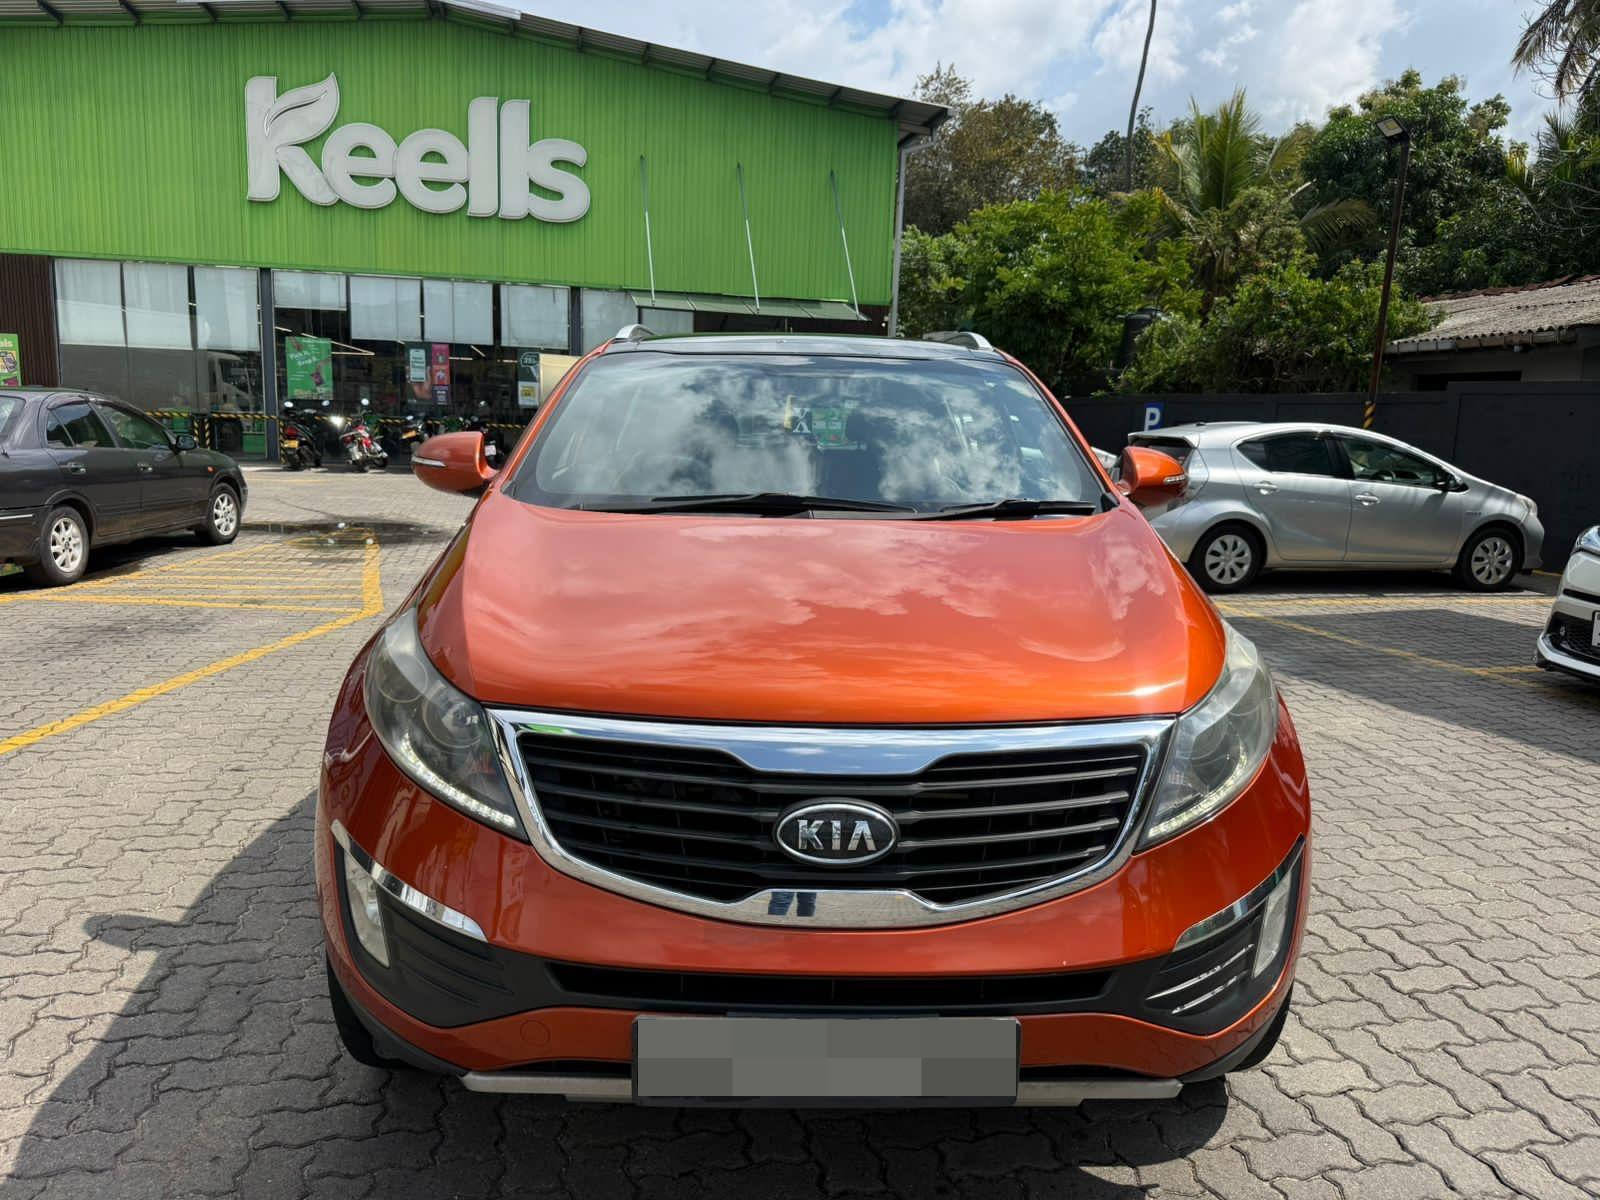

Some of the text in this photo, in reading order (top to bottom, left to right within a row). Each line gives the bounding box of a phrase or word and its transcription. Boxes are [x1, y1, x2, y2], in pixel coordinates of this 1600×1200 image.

[245, 72, 591, 223] Keells
[1144, 407, 1161, 432] P
[797, 819, 877, 851] KIA
